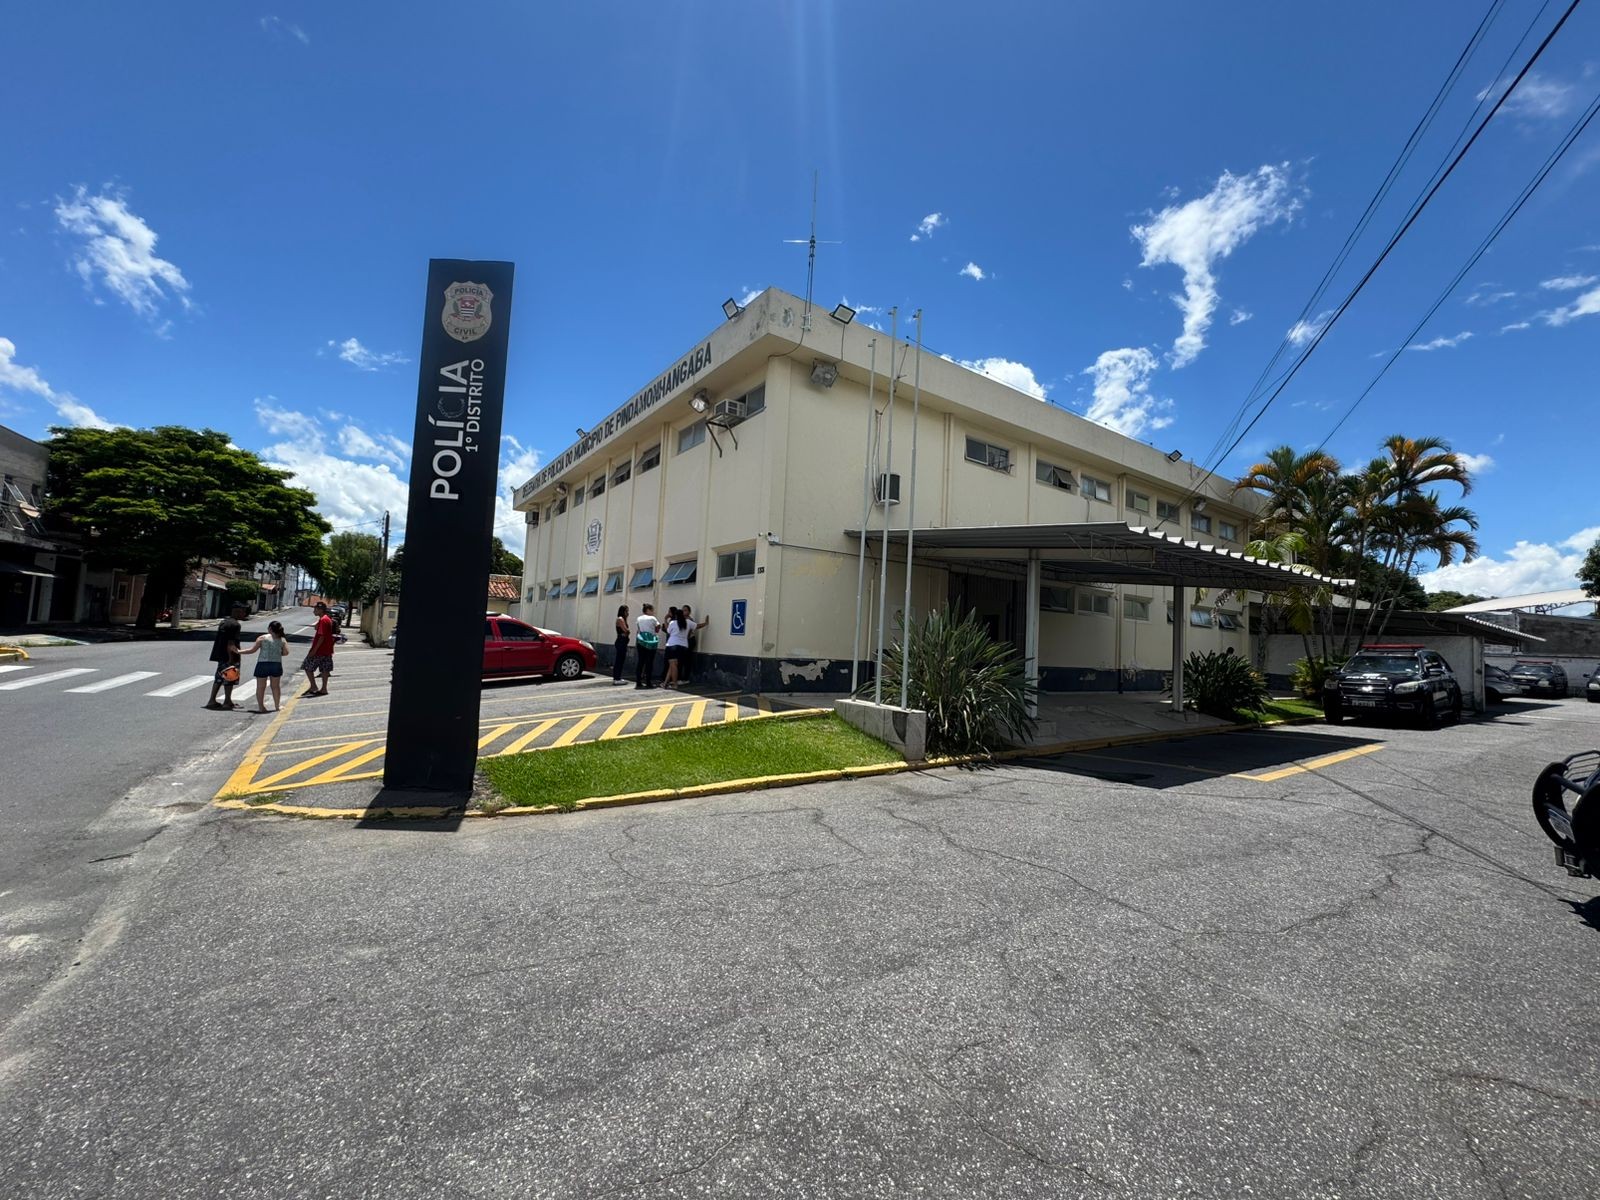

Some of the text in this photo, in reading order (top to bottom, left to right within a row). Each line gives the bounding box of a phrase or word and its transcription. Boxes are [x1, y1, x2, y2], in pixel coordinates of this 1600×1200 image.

[454, 327, 477, 336] CIVIL
[467, 358, 485, 433] DISTRITO
[604, 417, 614, 439] DE
[615, 342, 712, 432] PINDAMONHANGABA
